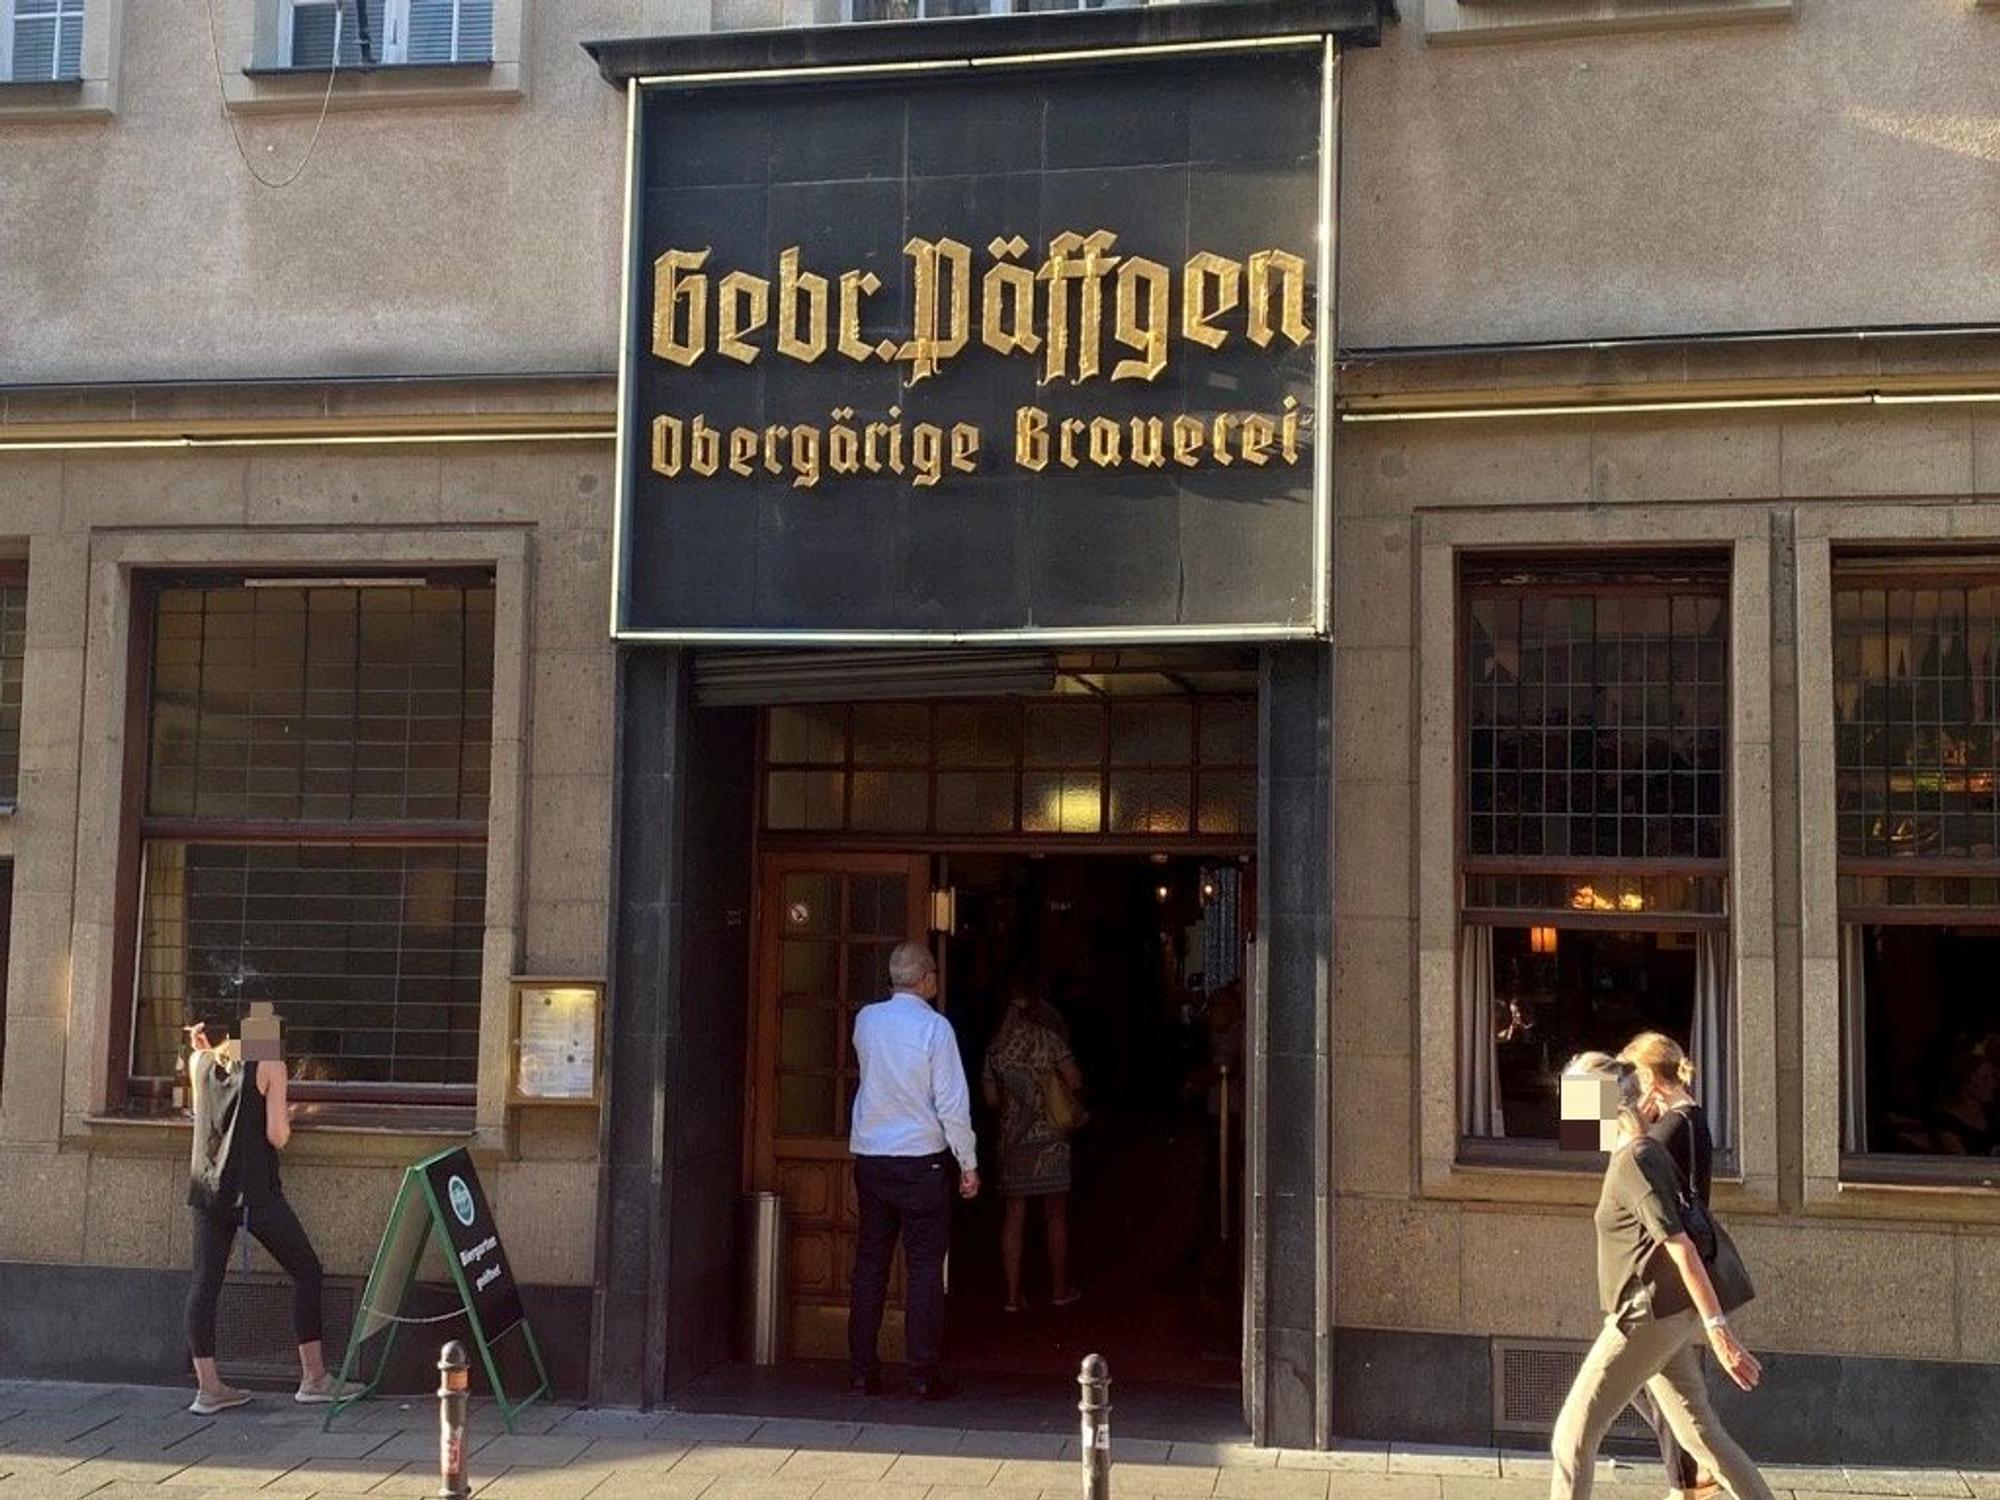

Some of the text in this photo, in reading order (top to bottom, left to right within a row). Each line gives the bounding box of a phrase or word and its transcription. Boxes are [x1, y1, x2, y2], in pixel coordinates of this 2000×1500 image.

[652, 229, 1313, 388] Gebr. Päffgen
[651, 396, 1299, 488] Obergärige Brauerei
